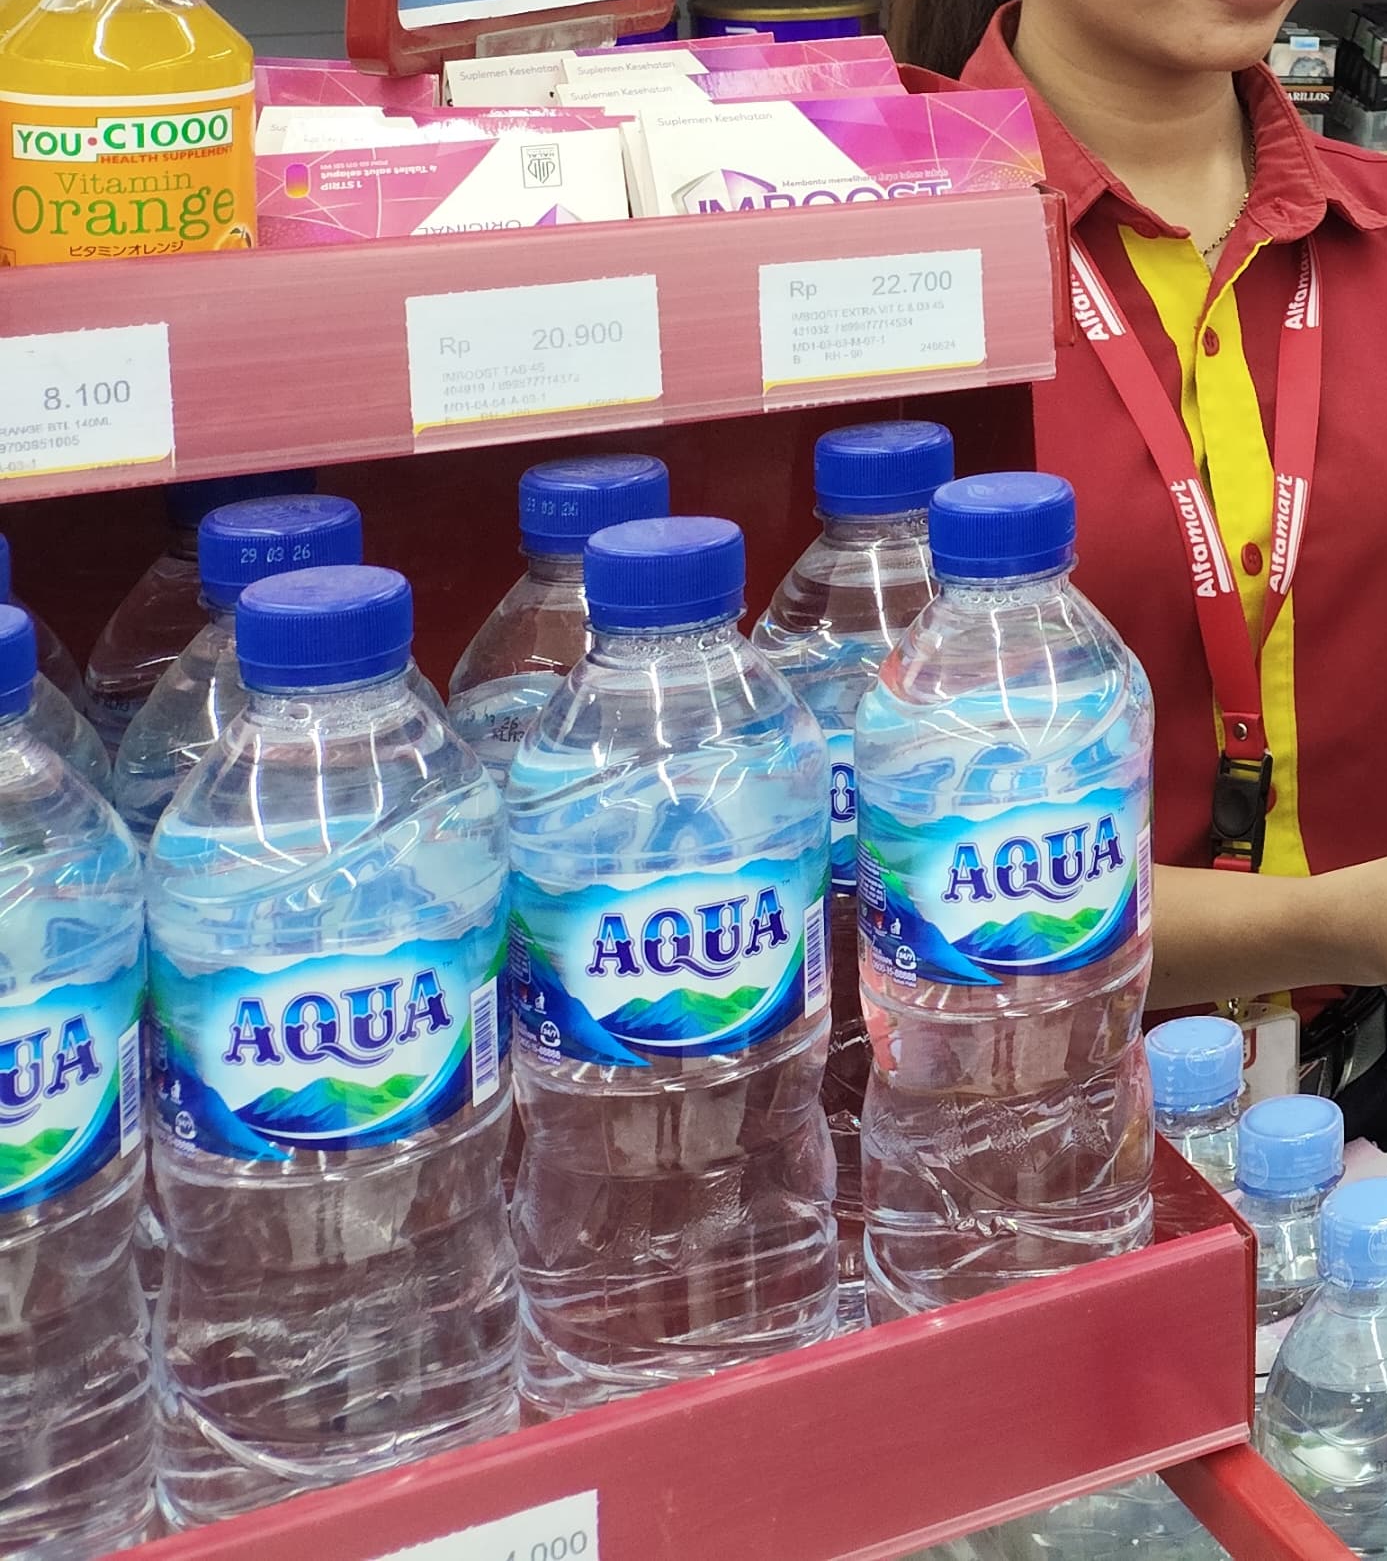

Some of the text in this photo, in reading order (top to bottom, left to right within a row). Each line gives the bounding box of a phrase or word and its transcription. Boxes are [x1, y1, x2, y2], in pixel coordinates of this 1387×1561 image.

[460, 63, 559, 82] Suplemen Kesehatan
[657, 110, 772, 129] Suplemen Kesehatan
[17, 114, 228, 156] YOU C1000
[101, 146, 233, 166] HEALTH SUPPLEMENT
[55, 169, 193, 196] Vitamin
[321, 181, 355, 191] STRIP
[782, 176, 826, 188] Membantu
[12, 185, 235, 240] Orange
[69, 239, 186, 258] ビタミンオレンジ
[790, 270, 952, 300] Rp 22.700
[841, 306, 876, 319] EXTRA
[440, 320, 623, 358] Rp 20.900
[44, 380, 131, 410] 8.100
[1169, 480, 1217, 598] Alfamart
[1269, 473, 1293, 594] Alfamart
[241, 544, 311, 564] 29 03 26
[942, 812, 1125, 904] AQUA
[586, 885, 791, 979] AQUA
[222, 968, 455, 1070] AQUA
